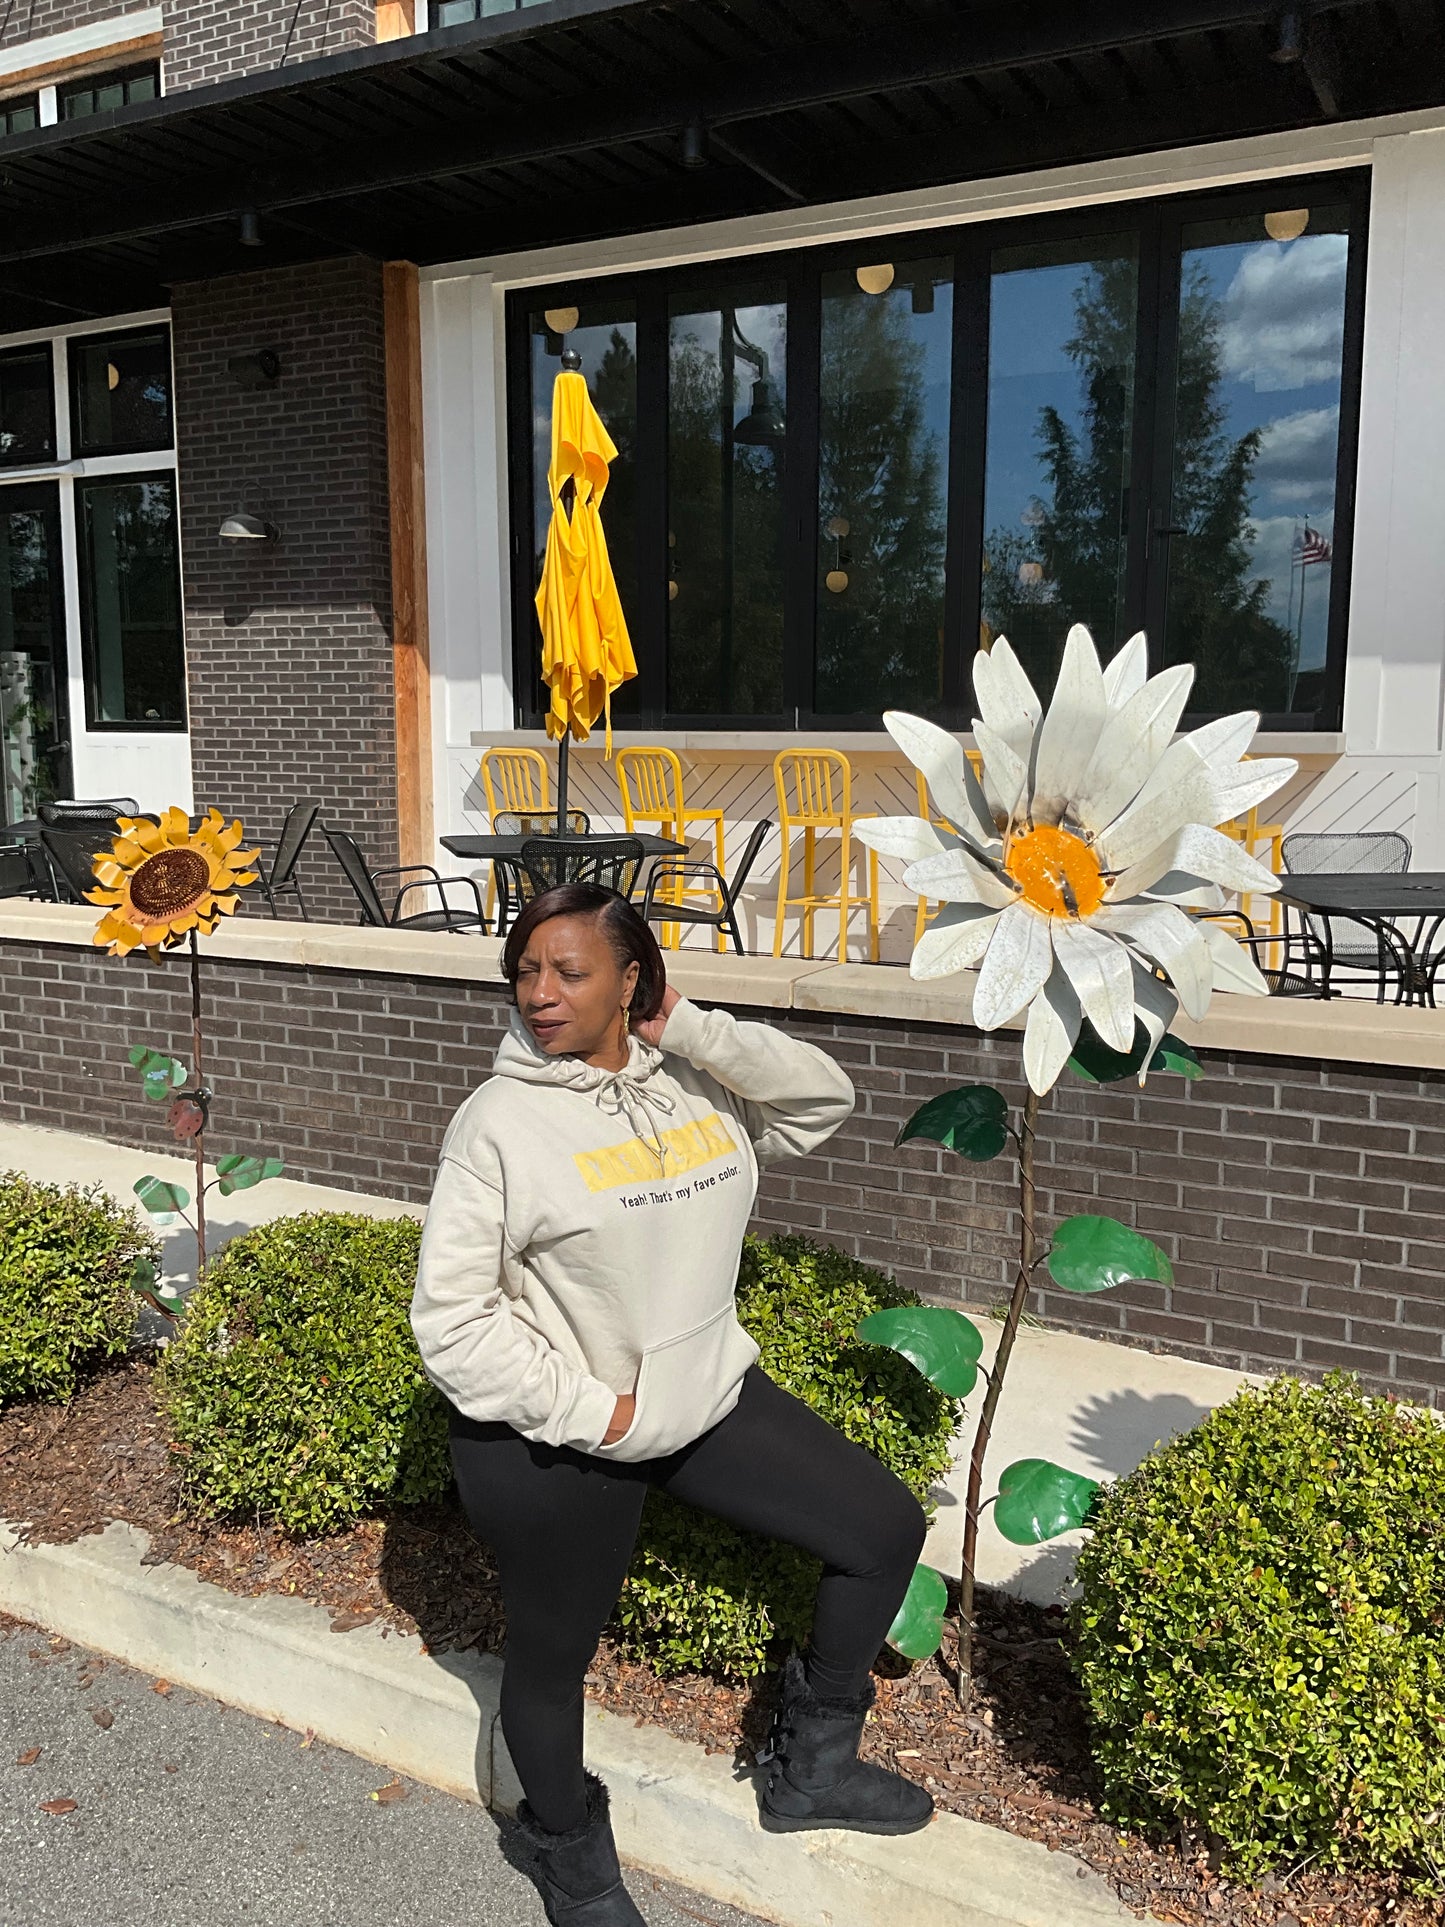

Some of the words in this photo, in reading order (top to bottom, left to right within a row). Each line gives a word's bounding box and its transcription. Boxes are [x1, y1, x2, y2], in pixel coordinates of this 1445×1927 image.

[619, 1193, 648, 1209] Yeah!
[649, 1190, 673, 1204] That's
[675, 1187, 691, 1198] my
[694, 1176, 716, 1192] fave
[718, 1165, 741, 1181] color.
